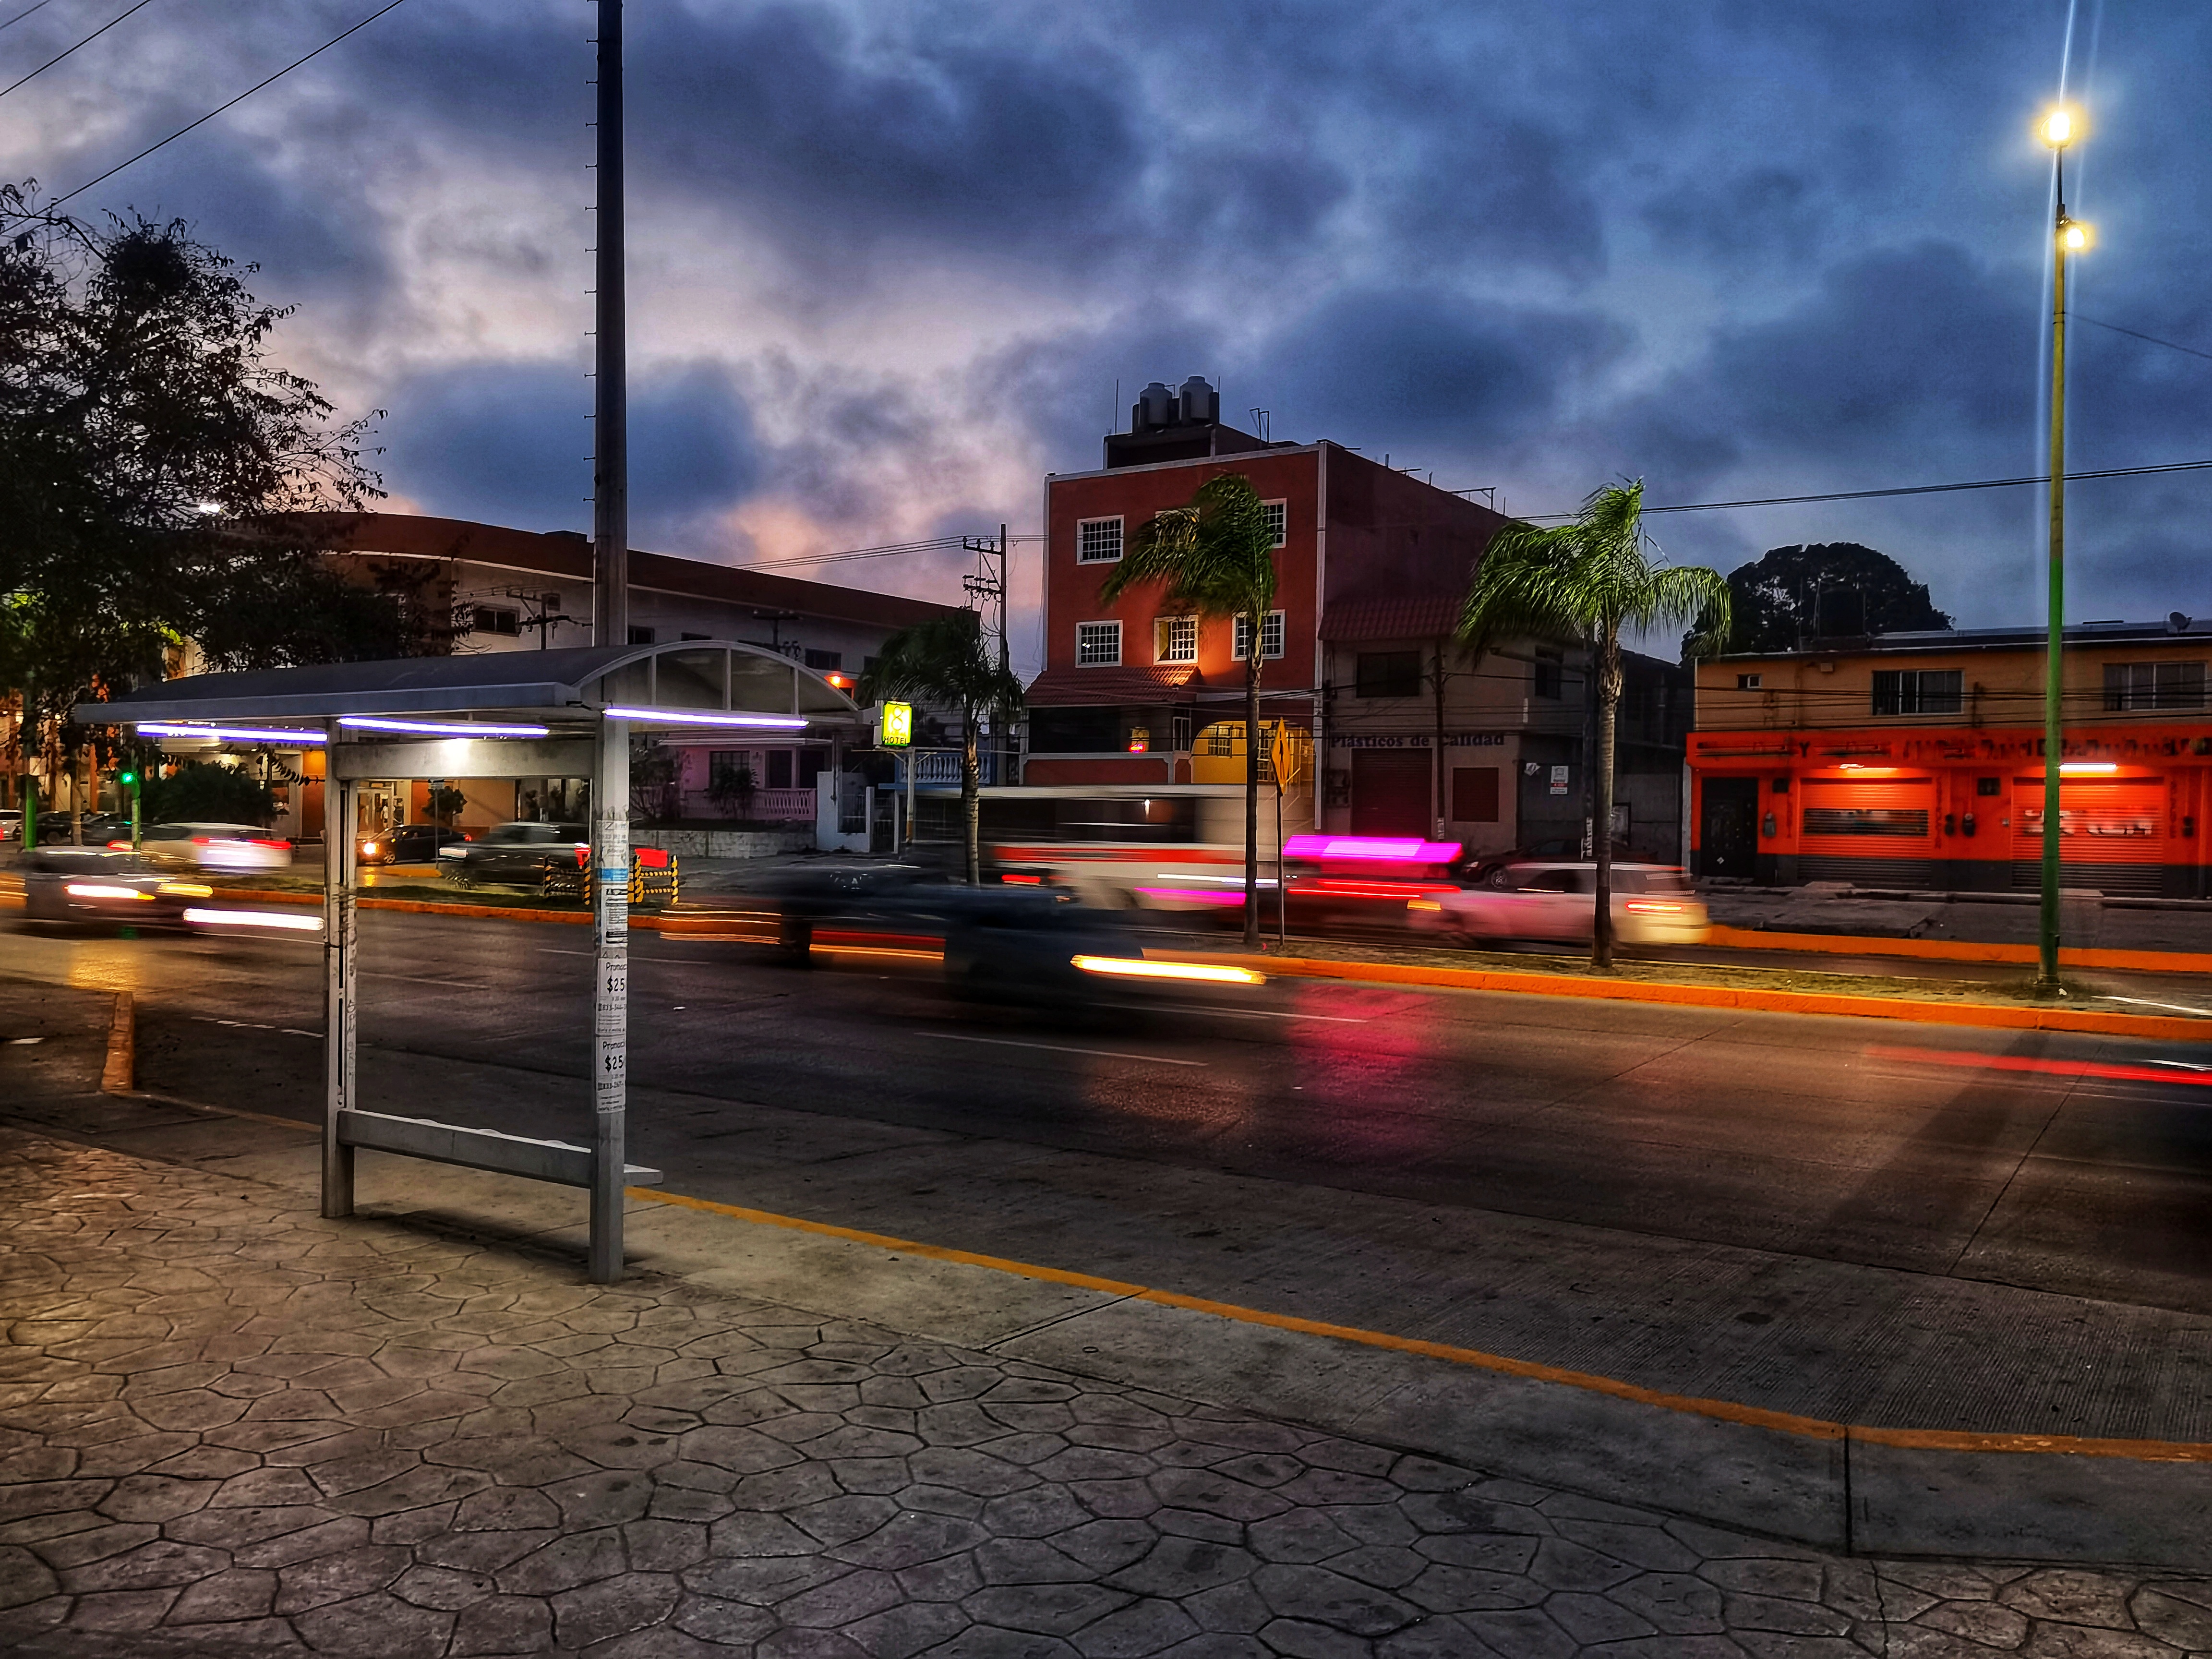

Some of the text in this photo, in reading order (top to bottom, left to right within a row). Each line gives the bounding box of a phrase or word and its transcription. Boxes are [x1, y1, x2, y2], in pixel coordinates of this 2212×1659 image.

[891, 706, 903, 731] 8
[884, 735, 907, 744] HOTEL
[1331, 734, 1403, 747] Plásticos
[1410, 734, 1430, 746] de
[606, 975, 625, 994] $25
[605, 1055, 624, 1073] $25
